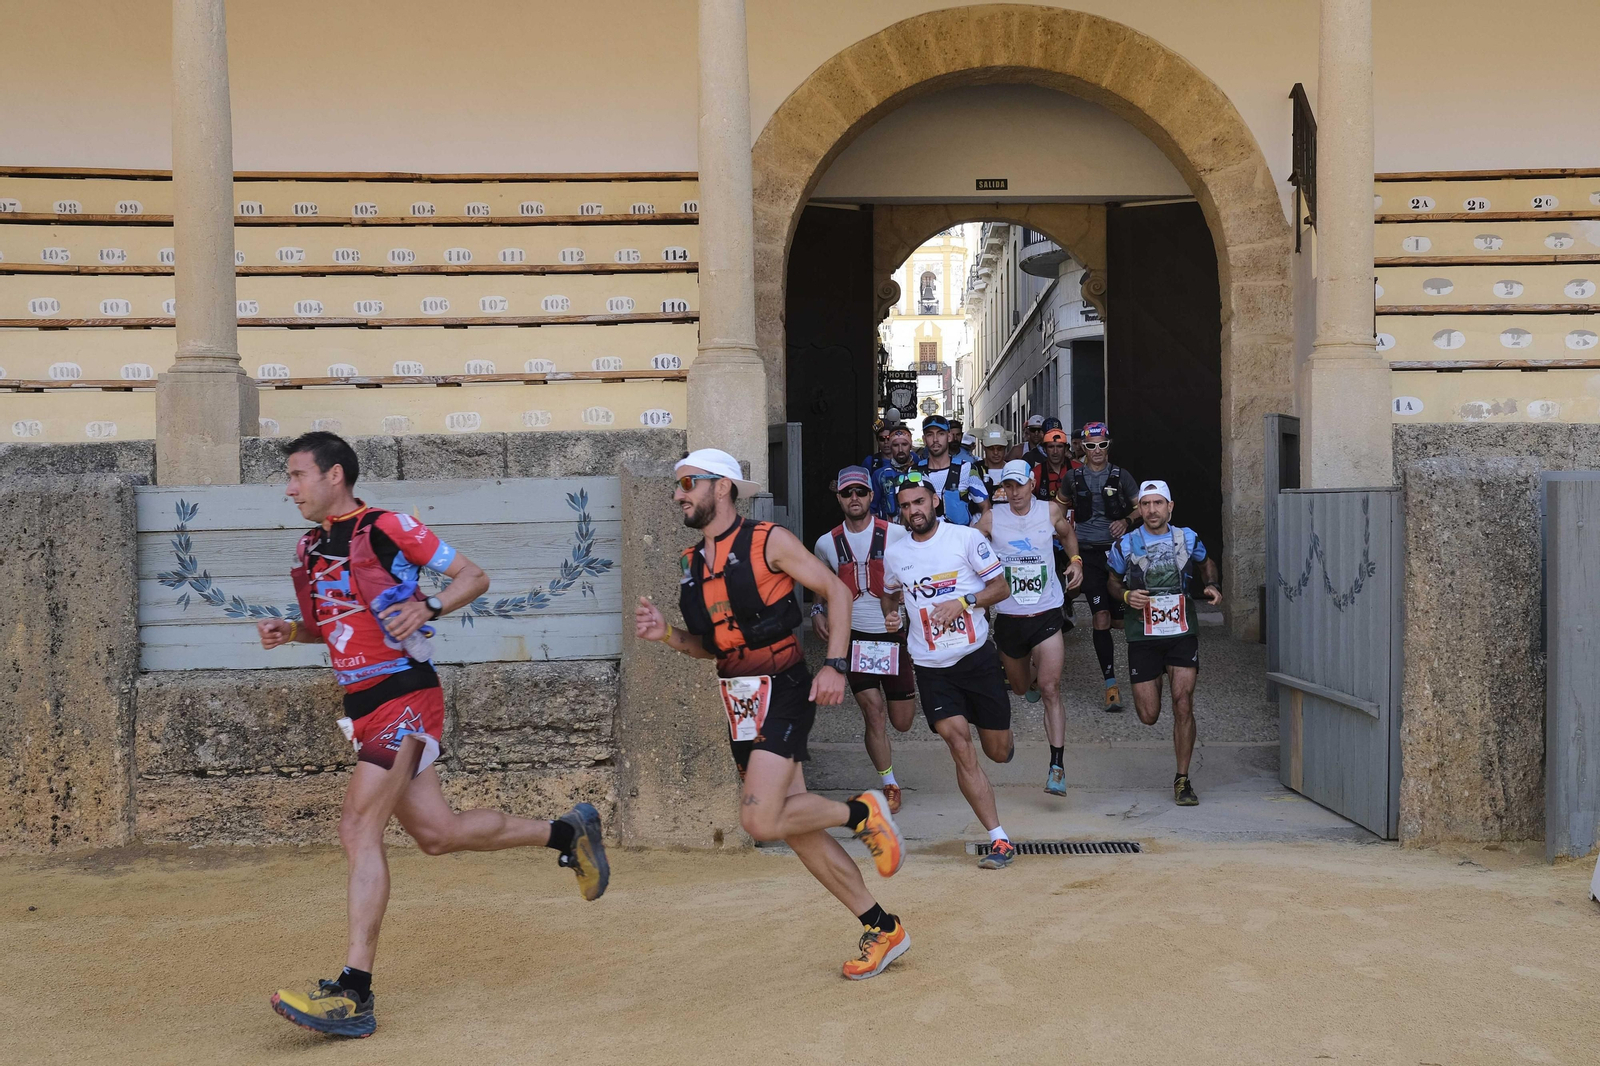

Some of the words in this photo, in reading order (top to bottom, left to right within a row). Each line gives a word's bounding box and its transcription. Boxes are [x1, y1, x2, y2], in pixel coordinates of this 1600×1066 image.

[58, 203, 77, 214] 98
[119, 203, 138, 214] 99
[240, 204, 263, 215] 101
[294, 204, 318, 215] 102
[411, 204, 435, 215] 104
[466, 205, 490, 216] 105
[520, 204, 543, 215] 106
[580, 205, 602, 215] 107
[631, 204, 655, 214] 108
[683, 203, 697, 213] 10
[100, 249, 127, 260] 104
[161, 251, 175, 262] 10
[278, 250, 304, 261] 107
[335, 250, 361, 262] 108
[391, 250, 415, 262] 109
[448, 250, 471, 262] 110
[502, 251, 524, 262] 111
[561, 250, 585, 262] 112
[662, 249, 688, 261] 114
[31, 300, 60, 313] 100
[103, 301, 130, 313] 101
[238, 302, 258, 313] 03
[297, 302, 323, 314] 104
[356, 301, 383, 313] 105
[422, 299, 449, 312] 106
[481, 299, 507, 311] 107
[543, 298, 570, 311] 108
[608, 299, 635, 311] 109
[661, 301, 687, 312] 110
[1377, 337, 1385, 347] A
[395, 363, 422, 374] 105
[466, 363, 494, 374] 106
[595, 358, 622, 370] 108
[654, 356, 682, 370] 109
[53, 366, 81, 378] 100
[125, 366, 151, 378] 101
[329, 366, 356, 377] 104
[643, 411, 673, 425] 105
[14, 421, 40, 437] 96
[88, 422, 114, 438] 97
[1012, 578, 1042, 591] 1069
[860, 657, 890, 671] 5343
